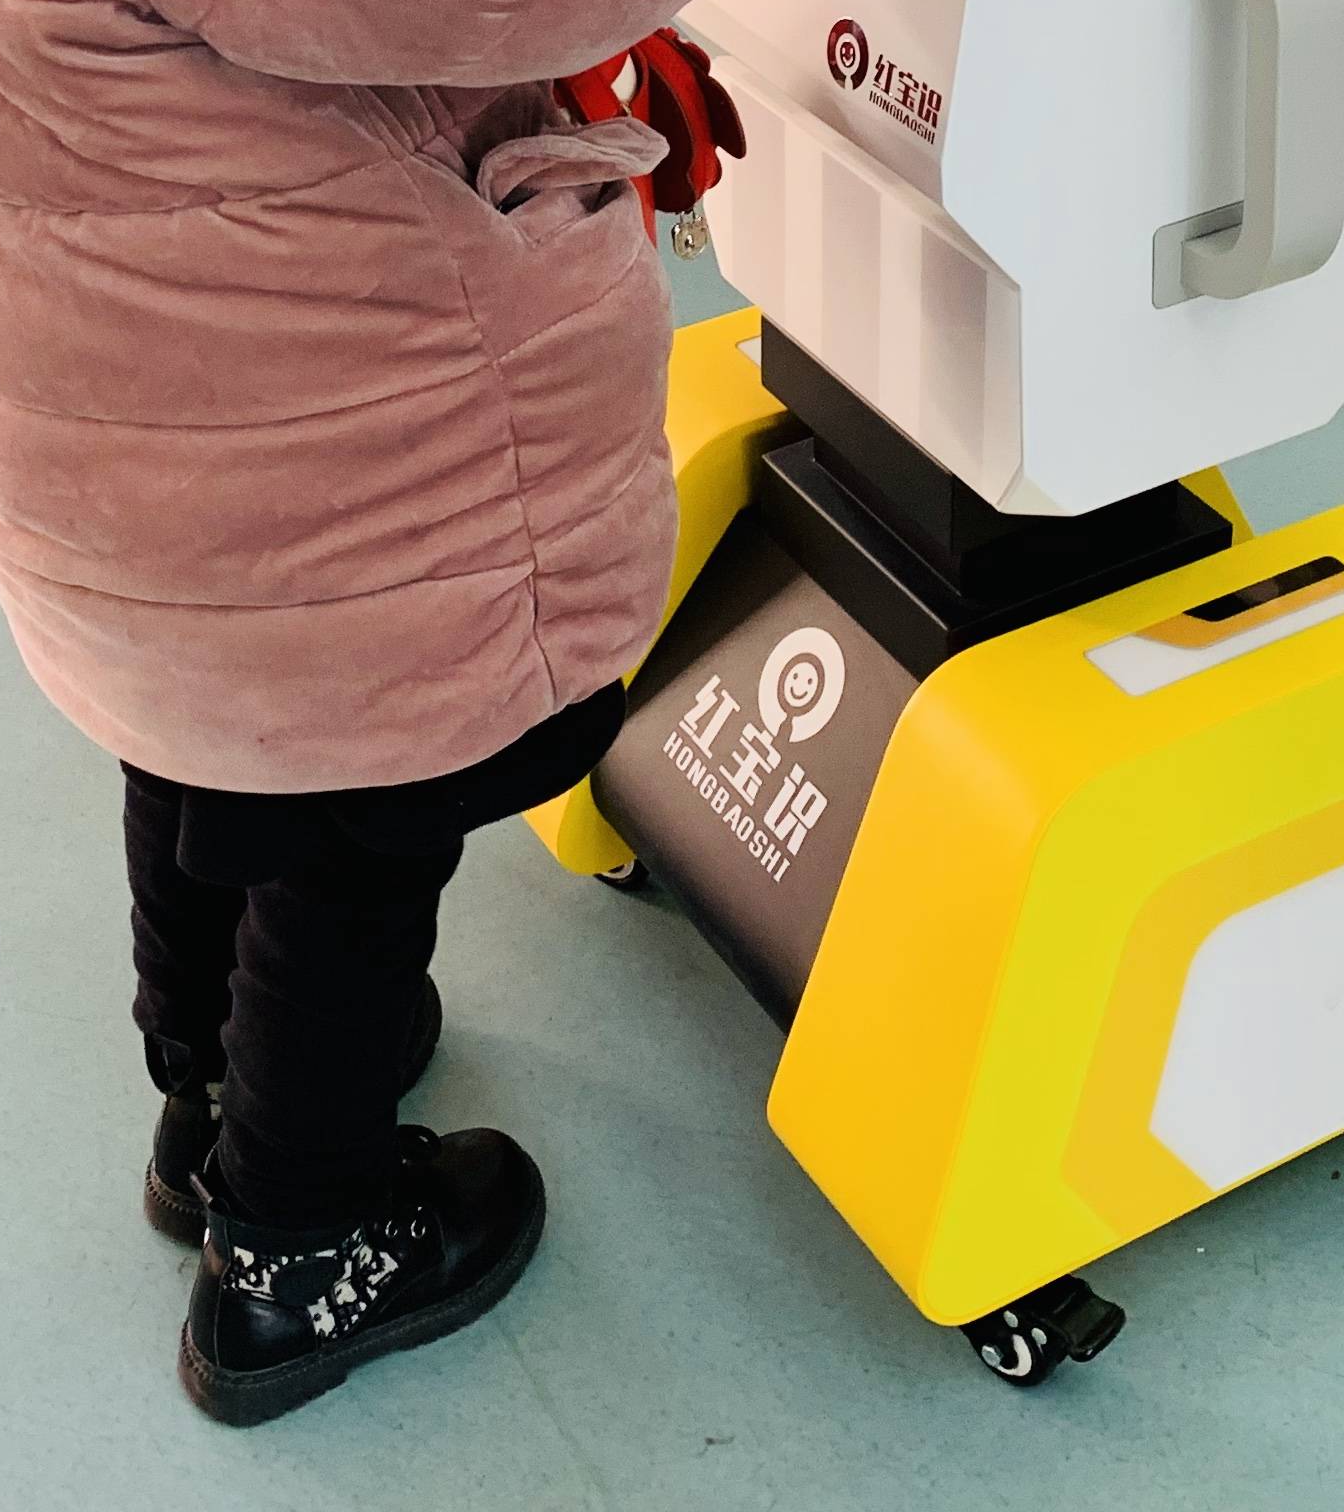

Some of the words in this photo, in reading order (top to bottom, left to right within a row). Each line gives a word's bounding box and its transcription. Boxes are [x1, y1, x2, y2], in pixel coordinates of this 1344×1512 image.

[868, 90, 936, 145] HONGBAOSHI
[872, 54, 943, 129] 红宝识
[662, 730, 792, 883] HONGBAOSHI
[678, 674, 829, 856] 红宝识
